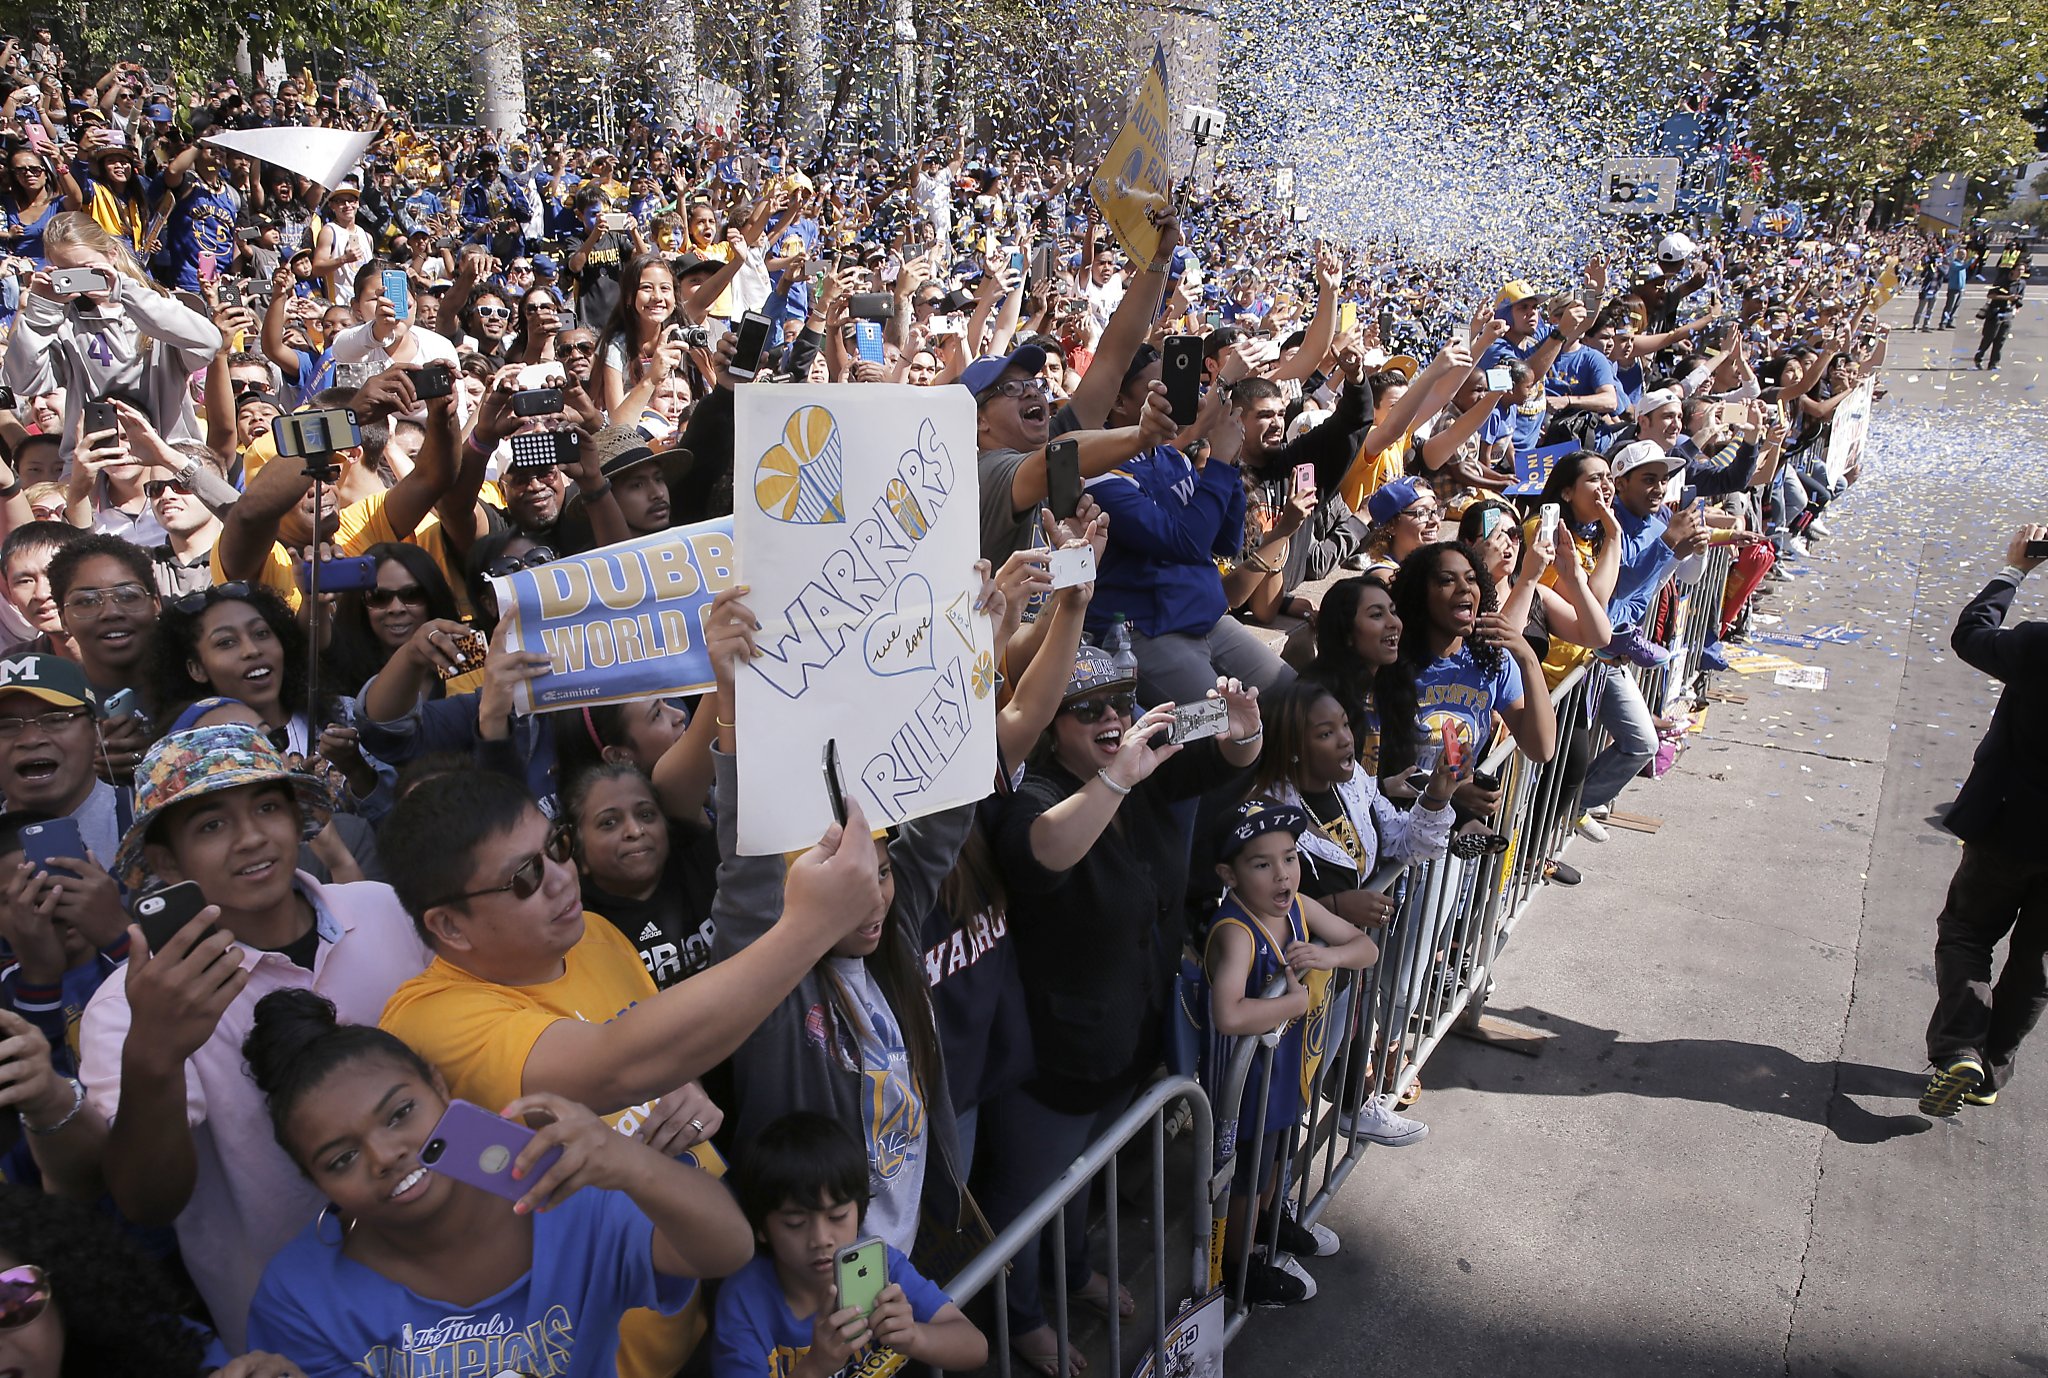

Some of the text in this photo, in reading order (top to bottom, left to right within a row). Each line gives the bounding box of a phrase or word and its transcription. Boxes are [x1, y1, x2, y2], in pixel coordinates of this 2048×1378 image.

[216, 225, 227, 243] 5
[88, 332, 113, 366] 4
[1170, 475, 1196, 507] W
[540, 608, 690, 676] WORLD
[872, 614, 931, 664] we love
[0, 656, 41, 686] M
[861, 656, 971, 823] RILEY
[1235, 822, 1252, 836] The
[1239, 814, 1301, 840] CITY
[639, 929, 662, 942] adidas
[413, 1329, 442, 1347] The
